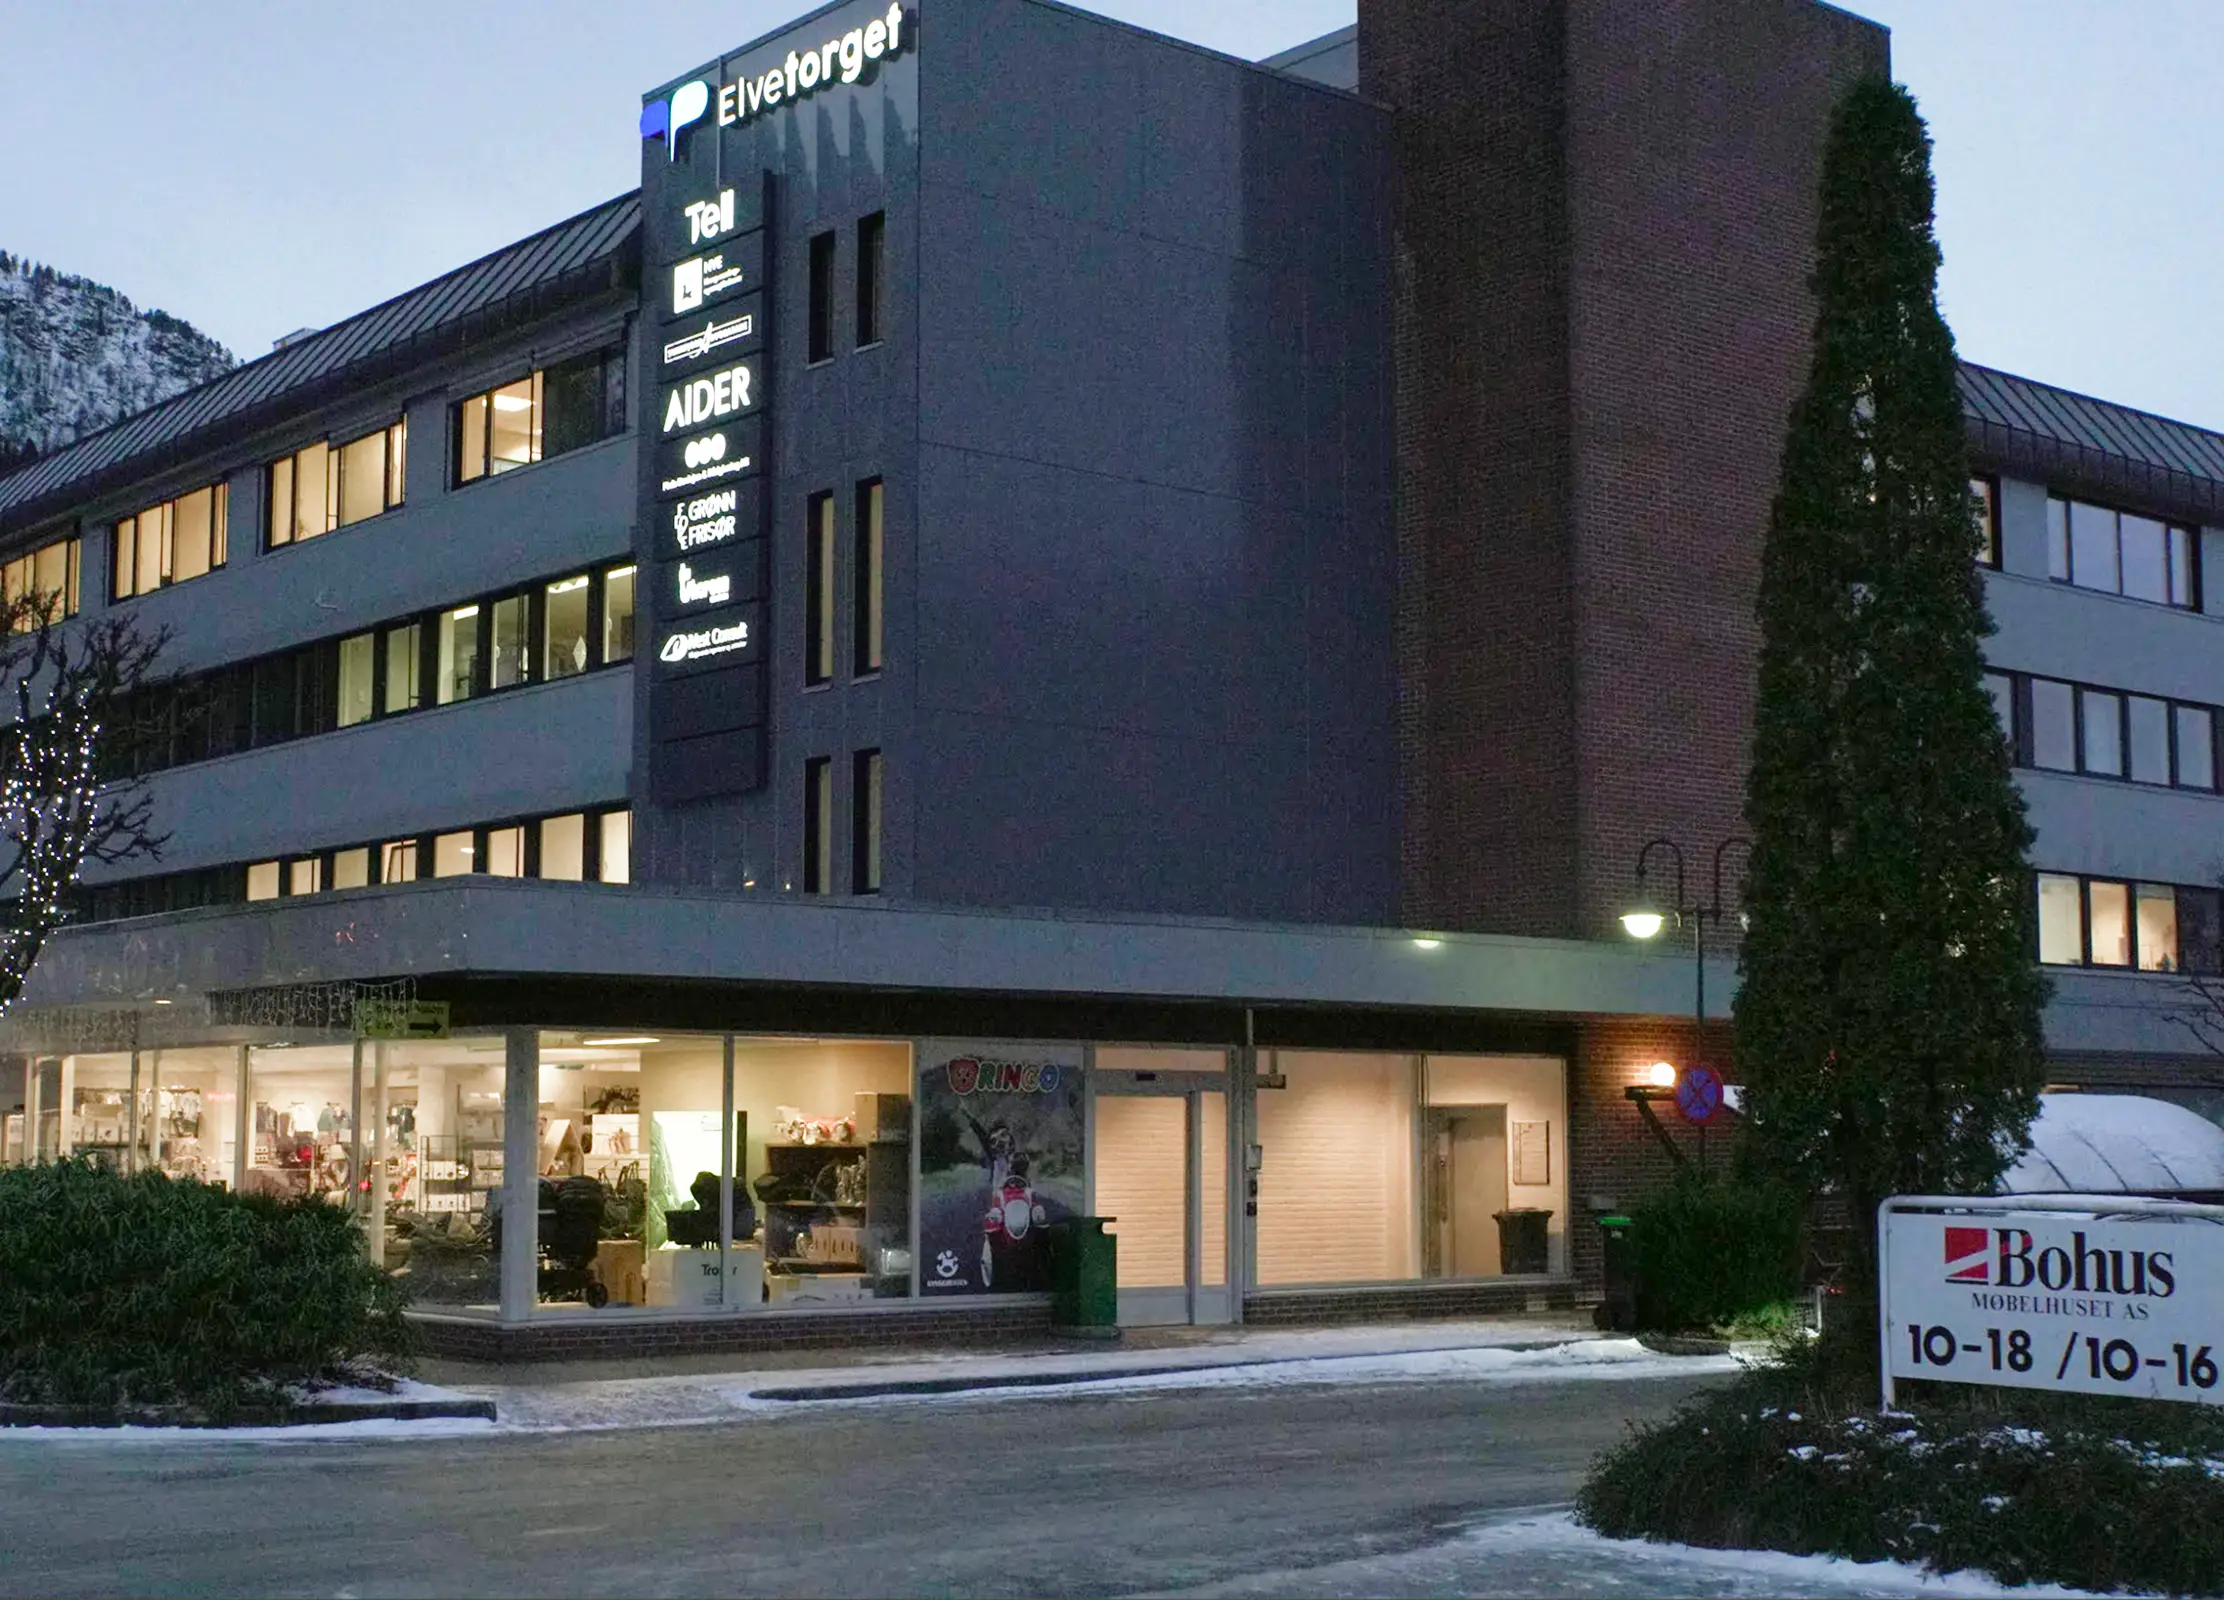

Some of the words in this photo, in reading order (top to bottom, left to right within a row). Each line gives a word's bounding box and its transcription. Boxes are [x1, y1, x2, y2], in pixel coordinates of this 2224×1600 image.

[719, 2, 902, 127] Elvetorget
[685, 189, 734, 244] Tell
[663, 366, 750, 432] AIDER
[688, 490, 736, 521] GRØNN
[688, 515, 736, 547] FRISØR
[1993, 1228, 2176, 1298] Bohus
[2122, 1302, 2149, 1320] AS
[1908, 1324, 2034, 1373] 10-18
